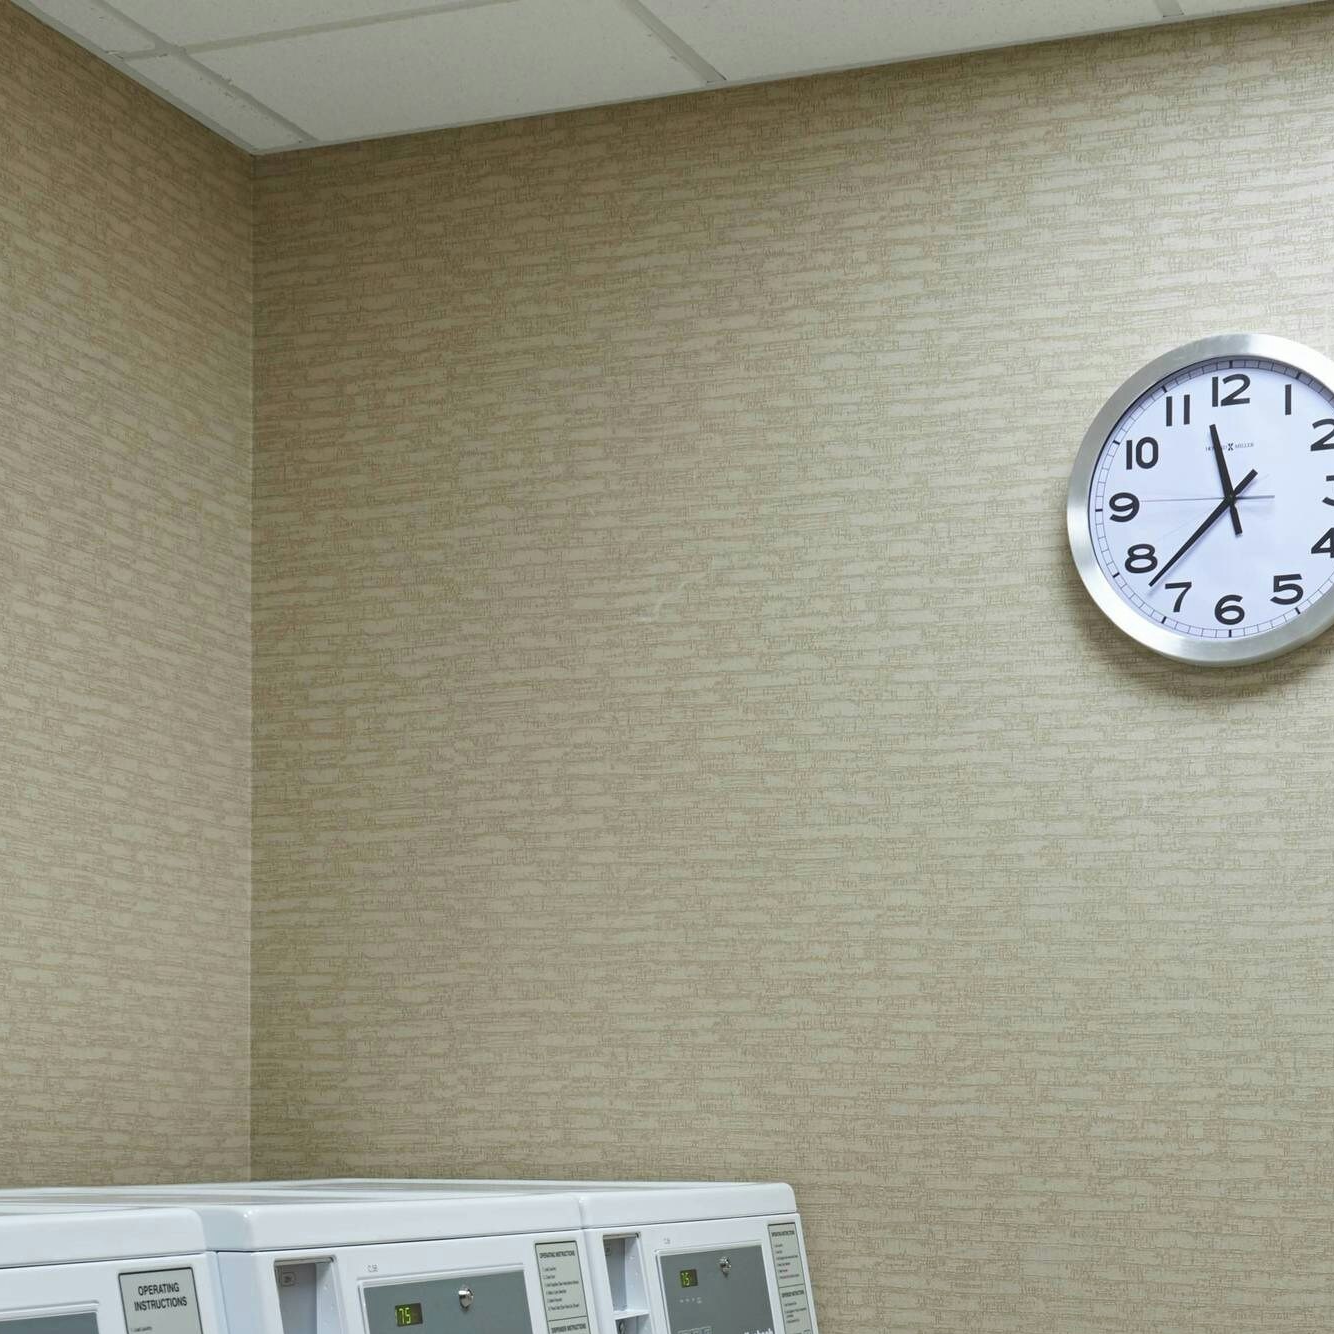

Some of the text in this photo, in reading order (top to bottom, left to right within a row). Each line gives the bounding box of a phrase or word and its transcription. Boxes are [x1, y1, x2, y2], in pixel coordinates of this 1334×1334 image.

[1212, 374, 1250, 407] 12
[1285, 384, 1292, 415] 1
[1166, 394, 1190, 426] 11
[1126, 437, 1159, 469] 10
[1109, 492, 1140, 522] 9
[1125, 543, 1158, 573] 8
[1165, 582, 1192, 613] 7
[1270, 574, 1303, 604] 5
[1215, 595, 1245, 625] 6
[134, 1297, 187, 1311] INSTRUCTIONS
[138, 1283, 179, 1296] OPERATING
